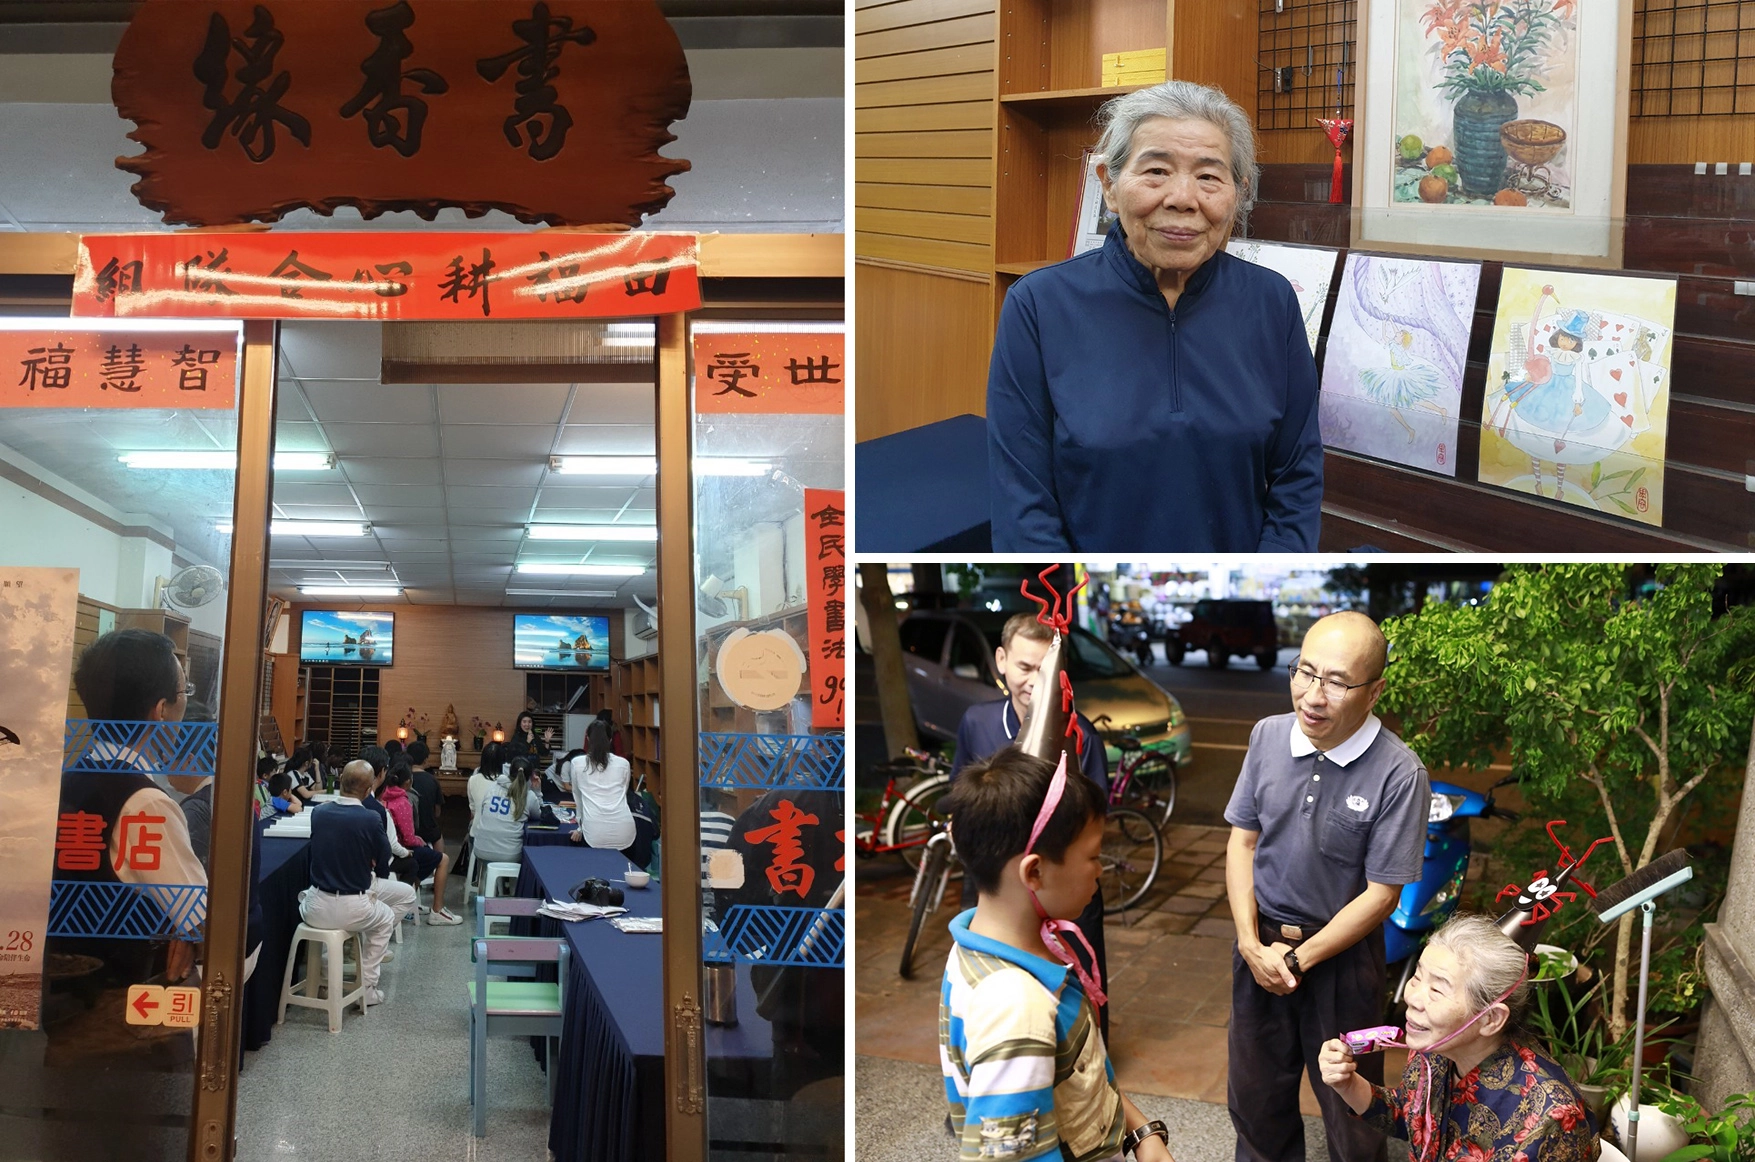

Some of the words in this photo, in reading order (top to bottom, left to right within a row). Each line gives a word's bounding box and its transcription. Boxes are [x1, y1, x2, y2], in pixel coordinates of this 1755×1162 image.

[193, 2, 597, 163] 書香緣
[489, 796, 512, 815] 59
[55, 810, 166, 871] 書店
[744, 800, 845, 899] 書
[170, 1015, 191, 1023] PULL
[172, 993, 193, 1013] 引
